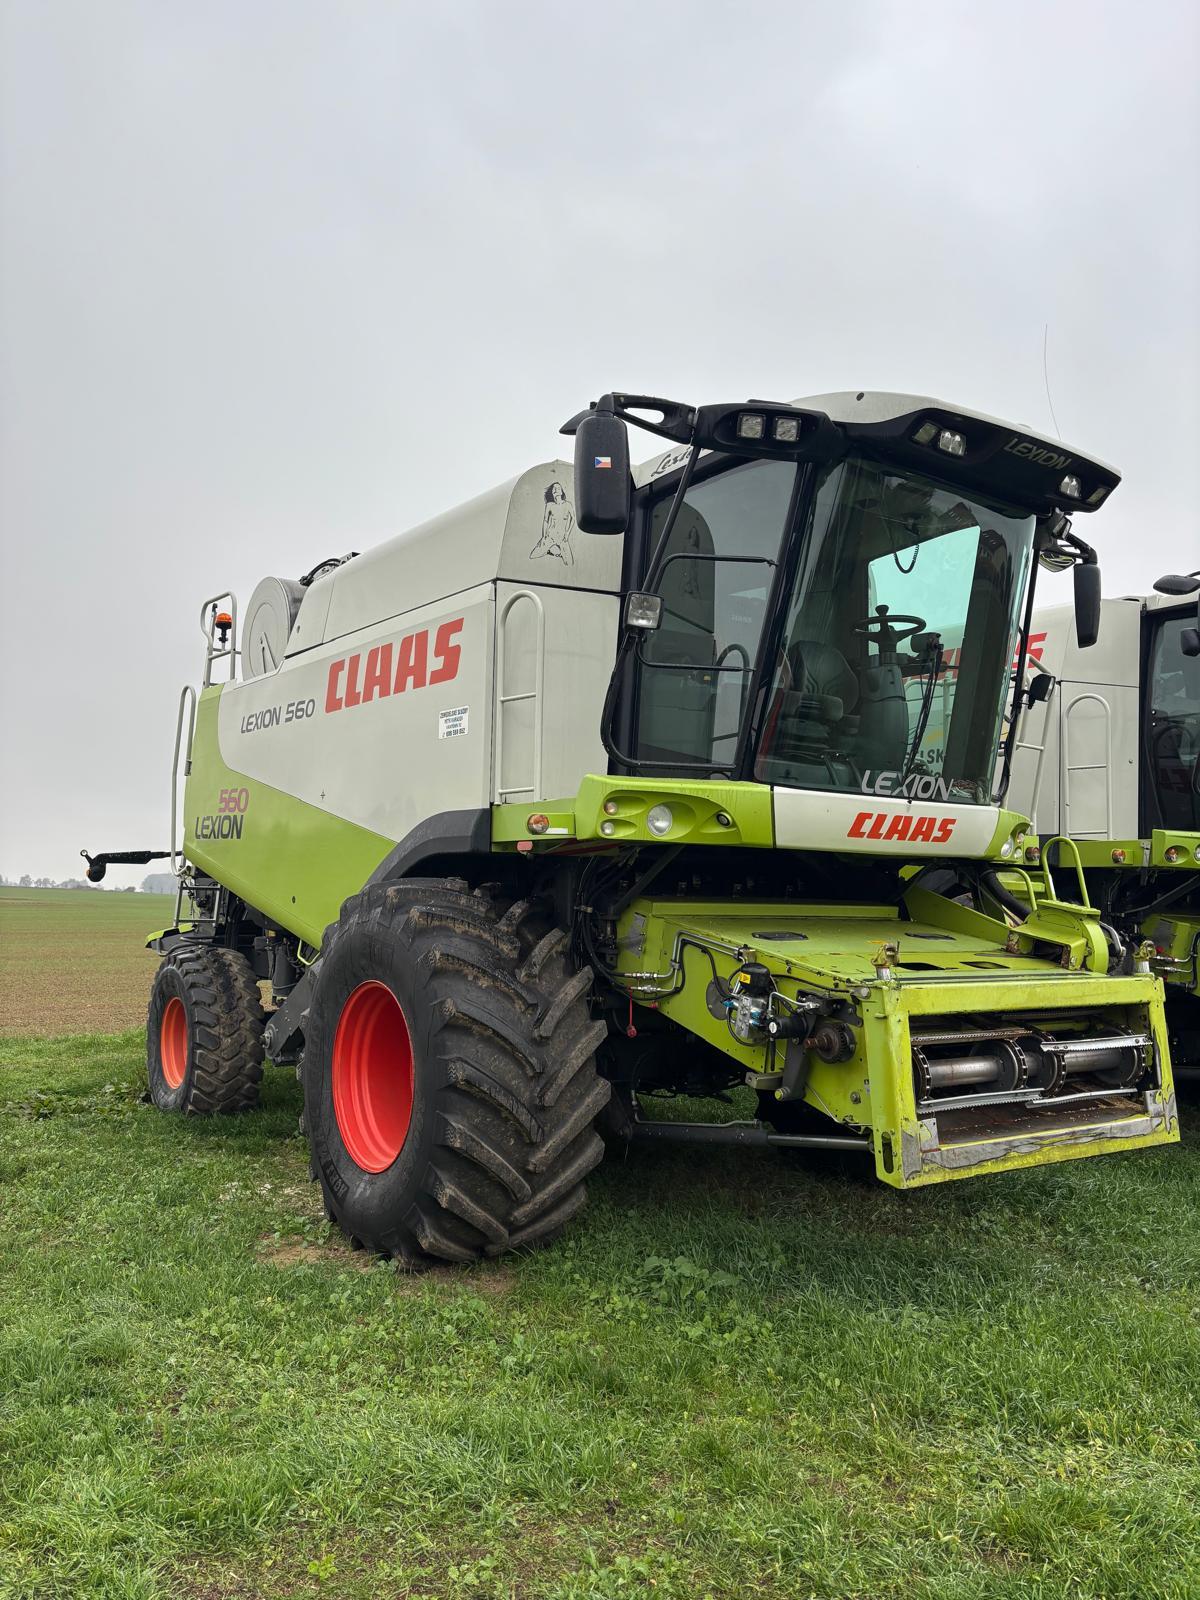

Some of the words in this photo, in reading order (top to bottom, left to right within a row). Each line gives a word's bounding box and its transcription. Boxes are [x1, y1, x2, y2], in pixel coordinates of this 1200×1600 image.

[1003, 438, 1071, 470] LEXION
[325, 617, 465, 714] CLAAS
[240, 705, 282, 734] LEXION
[284, 698, 316, 723] 560
[861, 770, 954, 801] LEXION
[194, 814, 244, 840] LEXION
[847, 812, 957, 843] CLAAS
